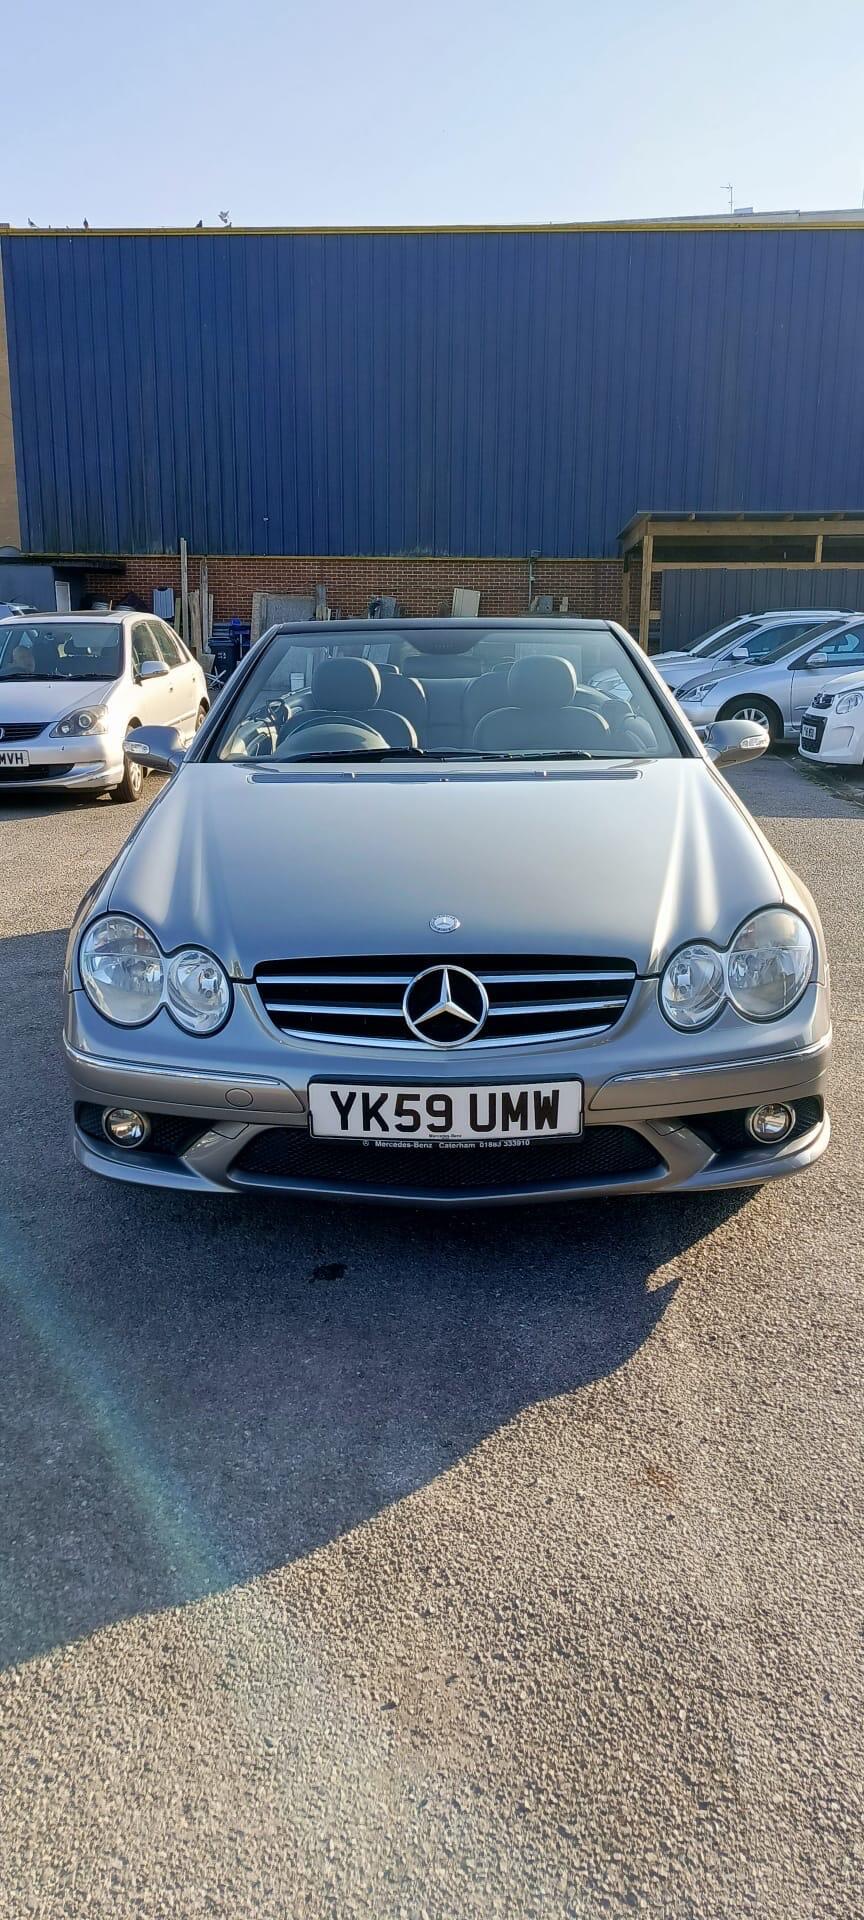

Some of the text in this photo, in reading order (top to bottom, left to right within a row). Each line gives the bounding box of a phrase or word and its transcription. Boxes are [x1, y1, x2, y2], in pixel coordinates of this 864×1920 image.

[330, 1089, 560, 1132] YK59 UMW
[374, 1140, 433, 1149] Mercedes-Benz
[438, 1141, 476, 1149] Caterham
